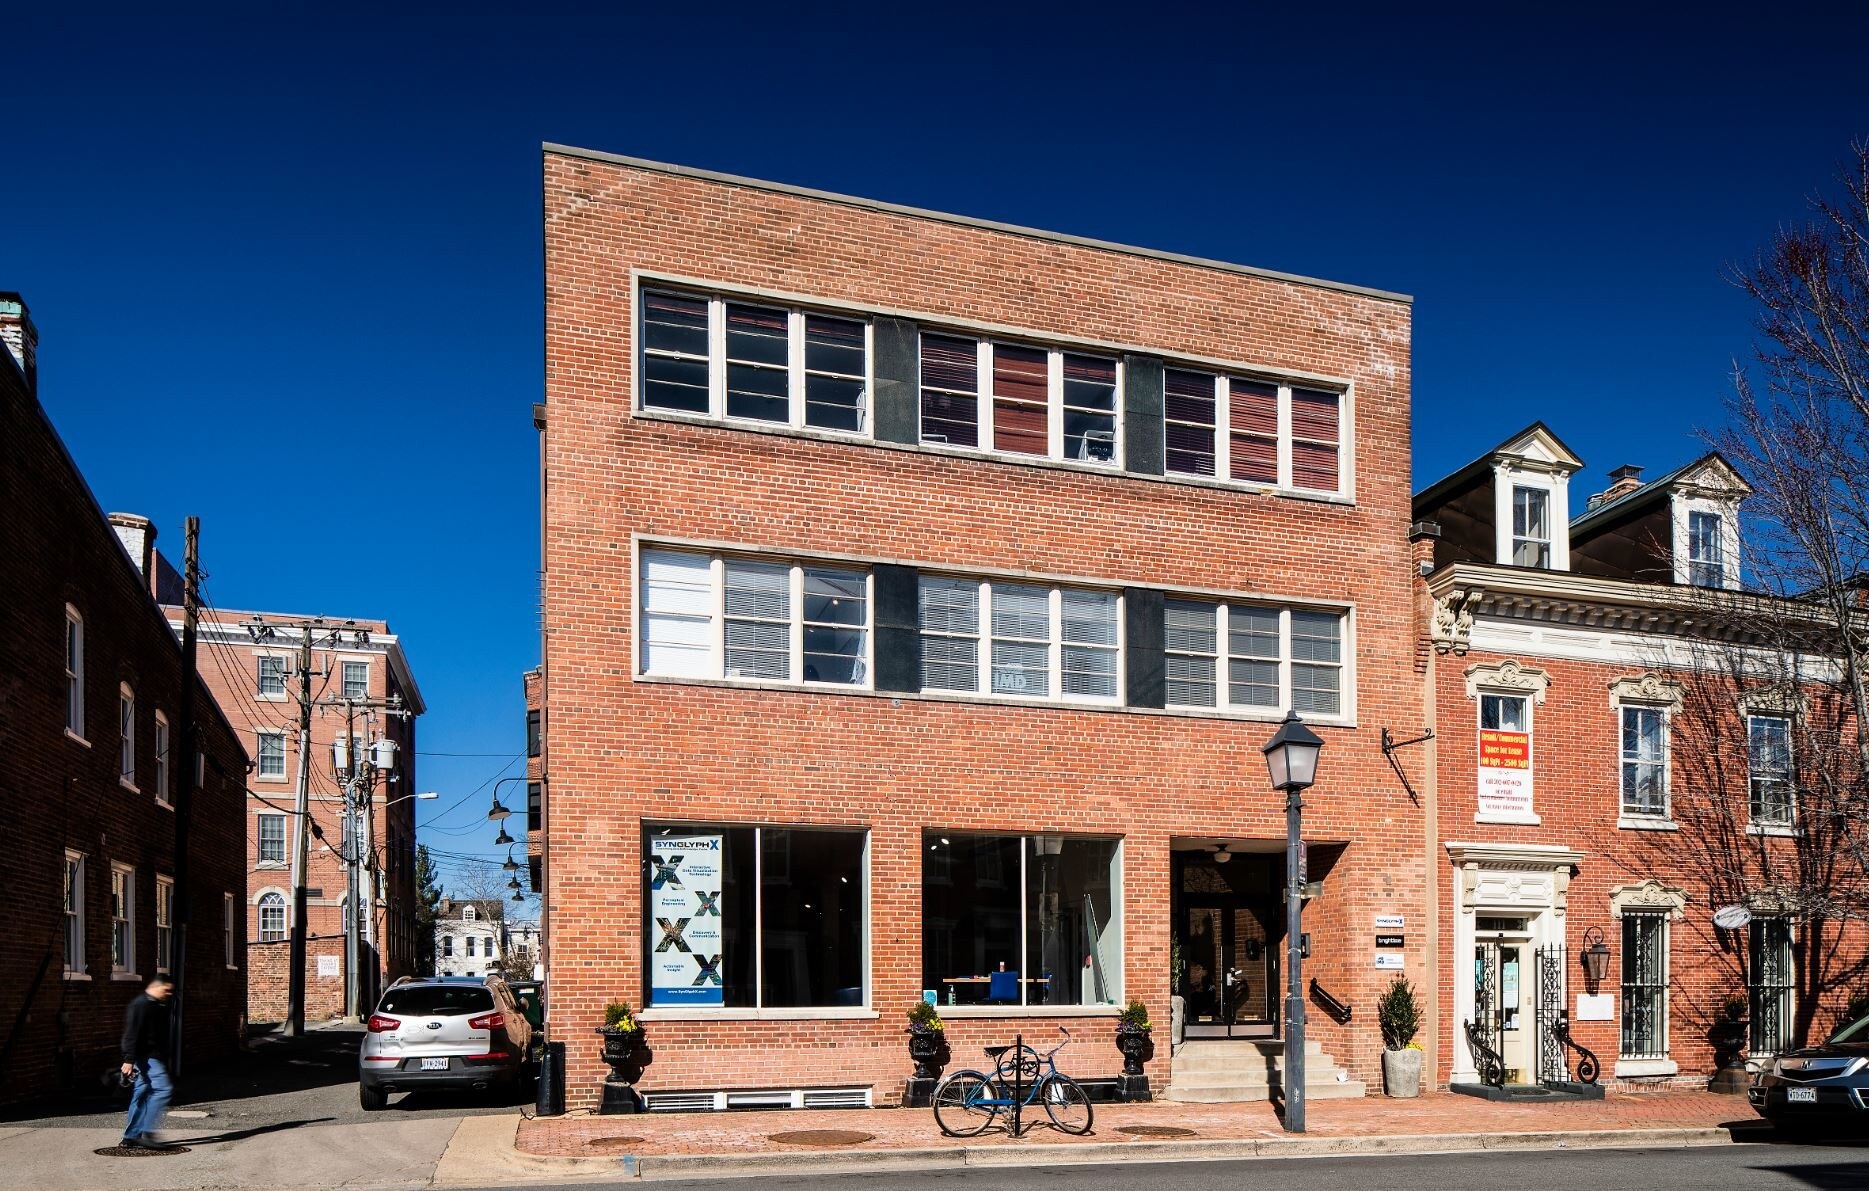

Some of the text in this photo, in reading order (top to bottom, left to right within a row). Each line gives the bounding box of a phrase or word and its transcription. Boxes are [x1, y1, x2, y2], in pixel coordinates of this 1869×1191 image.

[1481, 732, 1528, 744] Retail/Commercial
[1484, 745, 1523, 756] Space for Lease
[655, 840, 719, 851] SYNGLYPHX
